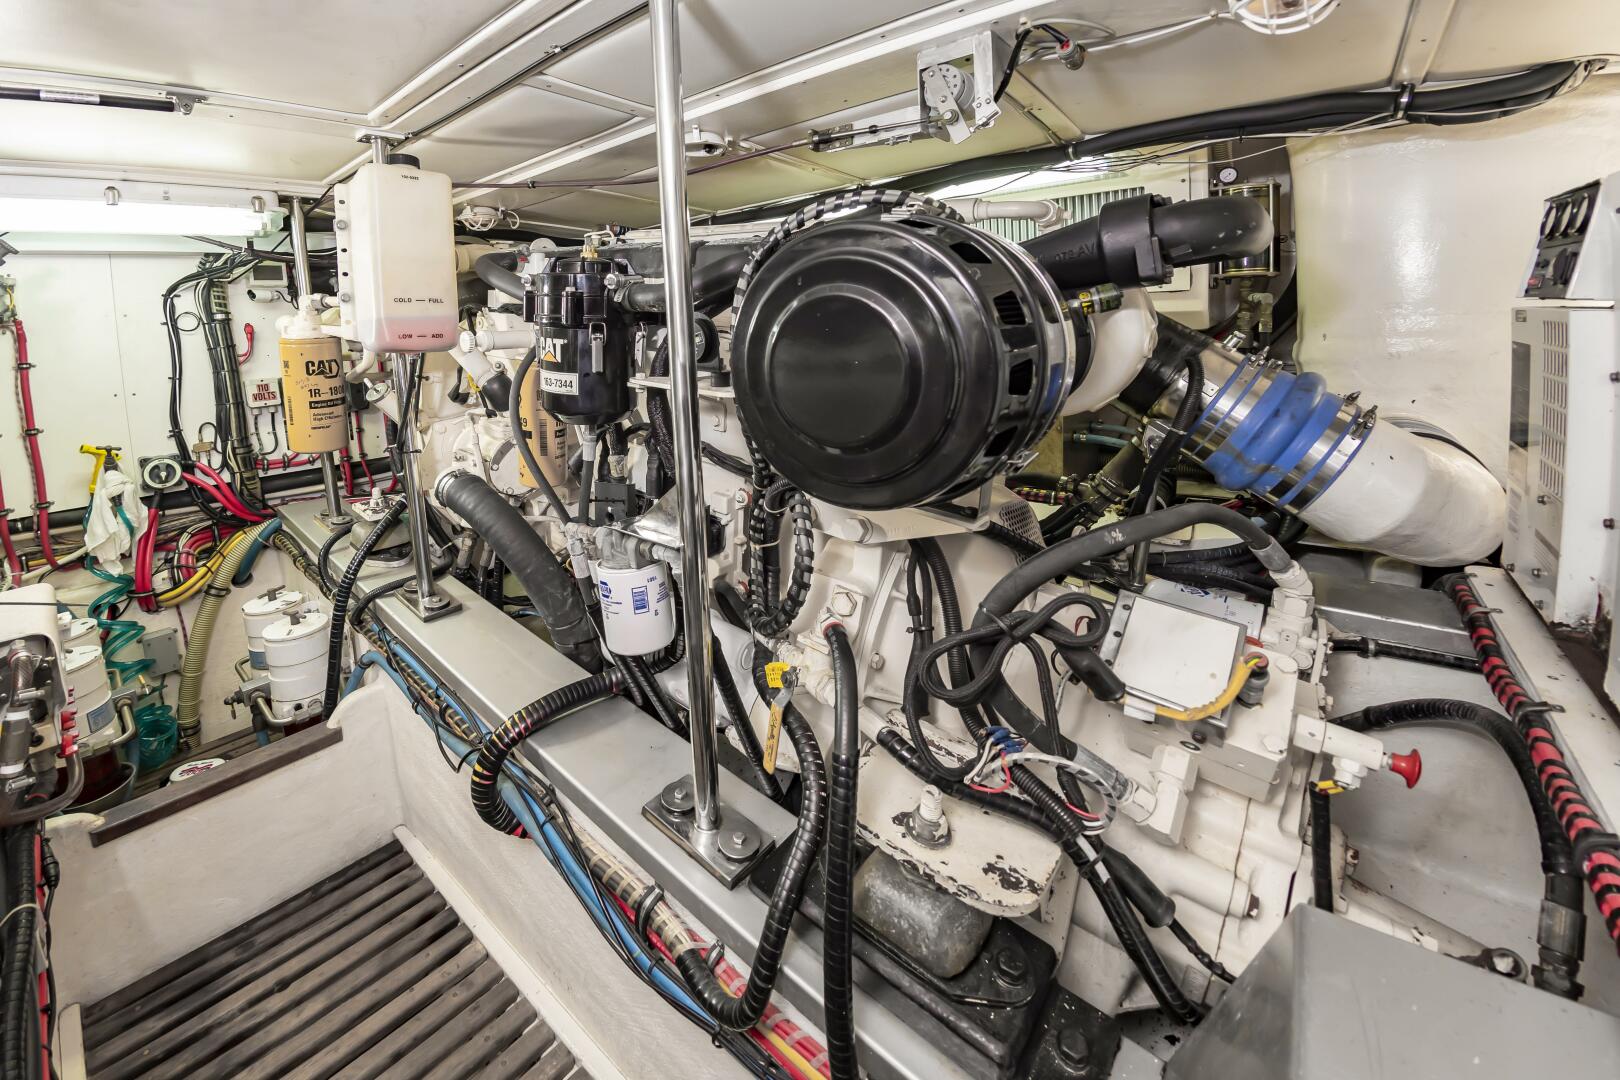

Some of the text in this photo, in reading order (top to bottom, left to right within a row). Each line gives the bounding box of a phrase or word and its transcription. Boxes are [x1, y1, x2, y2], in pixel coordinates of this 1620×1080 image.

[540, 336, 562, 363] CAT
[305, 358, 336, 377] CAT
[256, 383, 270, 392] 110
[252, 391, 277, 401] VOLTS
